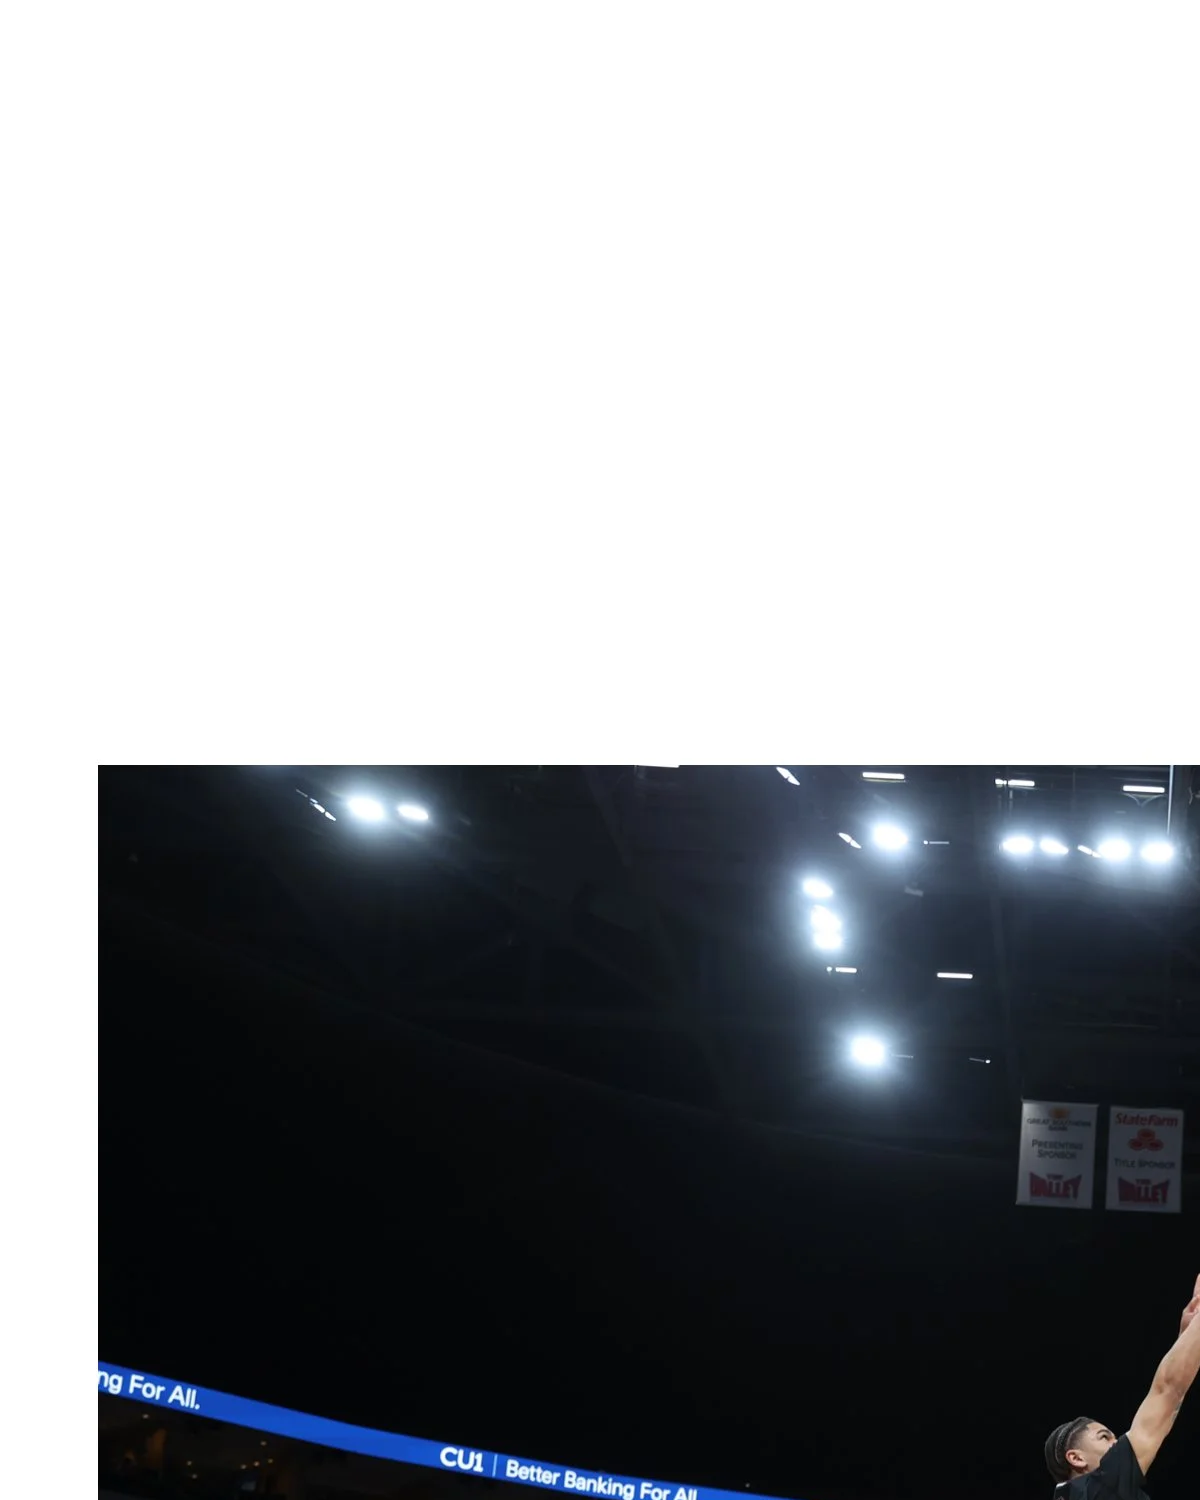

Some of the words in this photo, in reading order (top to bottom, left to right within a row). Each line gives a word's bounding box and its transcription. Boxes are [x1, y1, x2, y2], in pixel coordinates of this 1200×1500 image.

[129, 1373, 166, 1400] For
[168, 1385, 201, 1410] All.
[439, 1446, 484, 1473] CU1
[505, 1458, 561, 1486] Better
[563, 1470, 636, 1500] Banking
